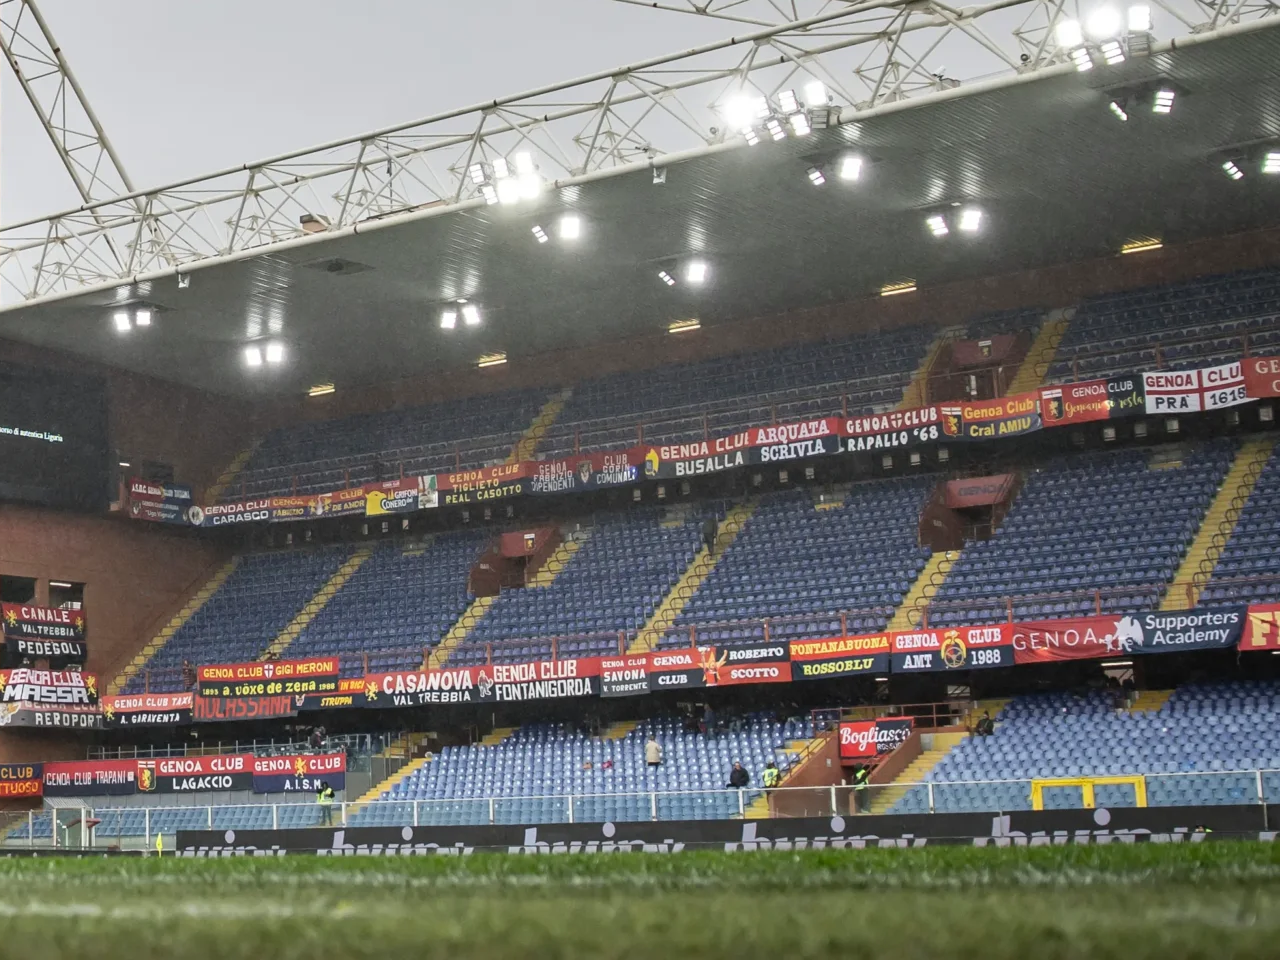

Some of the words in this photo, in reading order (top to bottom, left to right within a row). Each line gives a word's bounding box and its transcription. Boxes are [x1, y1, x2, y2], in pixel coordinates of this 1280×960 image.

[1146, 375, 1193, 388] GENOA
[1072, 386, 1106, 398] GENOA
[1108, 381, 1133, 393] CLUB
[964, 404, 1003, 420] Genoa
[1007, 399, 1034, 414] Club
[846, 415, 889, 433] GENOA
[905, 407, 937, 425] CLUB
[756, 420, 829, 444] ARQUATA
[970, 424, 995, 436] Cral
[848, 432, 908, 452] RAPALLO
[661, 441, 709, 460] GENOA
[761, 439, 826, 462] SCRIVIA
[605, 454, 627, 466] CLUB
[676, 451, 744, 476] BUSALLA
[449, 471, 483, 483] GENOA
[492, 464, 519, 476] CLUB
[452, 479, 499, 492] TIGLIETO
[340, 489, 363, 499] CLUB
[395, 489, 417, 498] GRIFONI
[446, 494, 470, 504] REAL
[477, 485, 521, 499] CASOTTO
[205, 504, 244, 515] GENOA
[246, 500, 270, 509] CLU
[213, 511, 269, 524] CARASCO
[22, 607, 70, 623] CANALE
[1145, 611, 1239, 632] Supporters
[22, 624, 74, 637] VALTREBBIA
[1152, 628, 1230, 646] Academy
[790, 636, 889, 655] FONTANABUONA
[895, 633, 939, 649] GENOA
[968, 628, 1002, 644] CLUB
[1013, 627, 1097, 651] GENOA
[19, 641, 81, 655] PEDEGOLI
[729, 647, 784, 660] ROBERTO
[602, 660, 625, 668] GENOA
[627, 657, 647, 666] CLUB
[653, 655, 692, 666] GENOA
[903, 653, 933, 669] AMT
[971, 649, 1001, 665] 1988
[204, 668, 233, 678] GENOA
[238, 667, 262, 677] CLUB
[276, 665, 293, 675] GIGI
[297, 662, 332, 674] MERONI
[493, 663, 537, 683] GENOA
[540, 660, 577, 679] CLUB
[730, 667, 779, 679] SCOTTO
[803, 658, 875, 676] ROSSOBLU
[9, 669, 51, 685] GENOA
[54, 673, 84, 687] CLUB
[383, 670, 473, 694] CASANOVA
[604, 669, 646, 682] SAVONA
[658, 674, 688, 685] CLUB
[3, 684, 89, 703] MASSA
[267, 682, 281, 693] de
[285, 680, 316, 692] zena
[495, 678, 592, 701] FONTANIGORDA
[611, 682, 647, 692] TORRENTE
[114, 699, 143, 708] GENOA
[146, 697, 168, 707] CLUB
[320, 696, 352, 706] STRUPPA
[393, 695, 413, 705] VAL
[418, 691, 471, 703] TREBBIA
[121, 716, 128, 724] A.
[841, 727, 910, 751] Bogliasco
[160, 760, 203, 773] GENOA
[211, 758, 244, 771] CLUB
[255, 759, 291, 772] GENOA
[310, 757, 341, 770] CLUB
[1, 767, 33, 778] CLUB
[46, 773, 70, 786] GENOA
[74, 772, 91, 785] CLUB
[96, 770, 125, 784] TRAPANI
[173, 776, 232, 790] LAGACCIO
